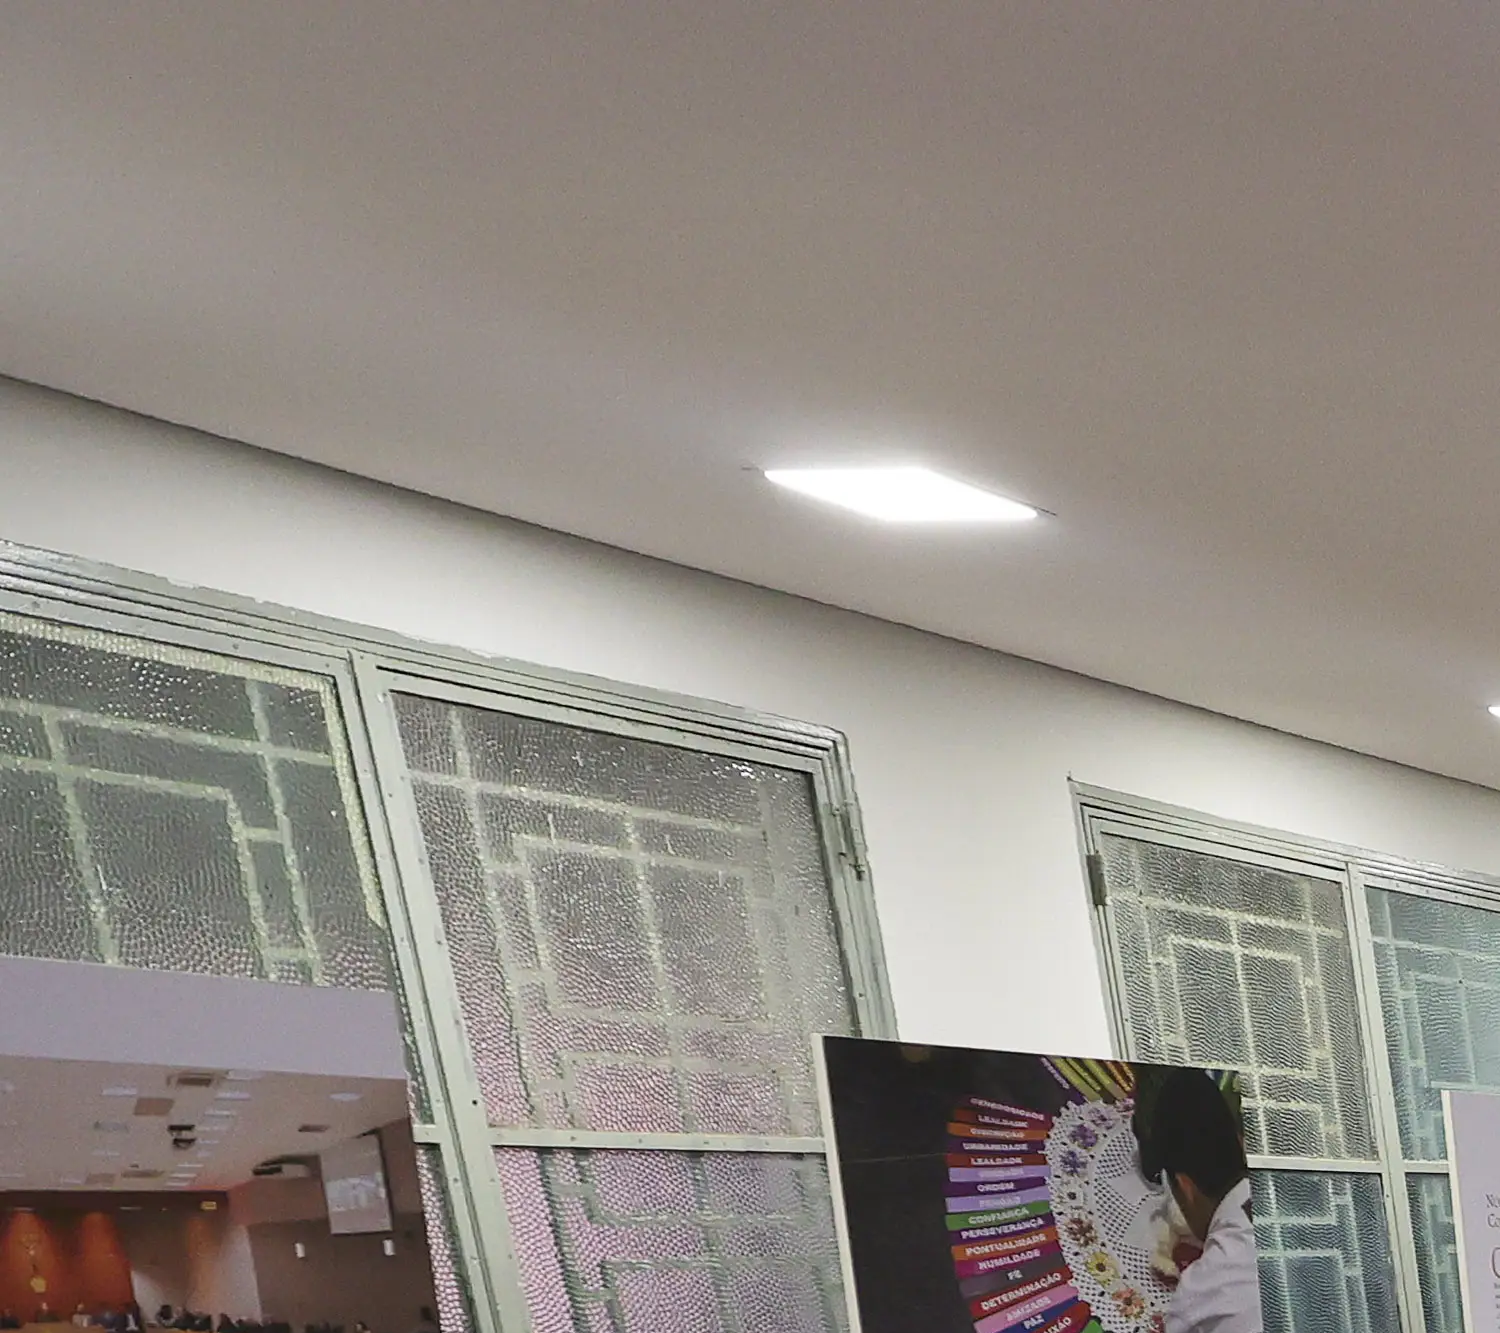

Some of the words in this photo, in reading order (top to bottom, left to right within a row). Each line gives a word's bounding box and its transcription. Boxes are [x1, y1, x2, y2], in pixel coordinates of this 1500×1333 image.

[978, 1249, 1040, 1270] HUMILDADE
[980, 1272, 1061, 1310] DETERMINAÇÃO
[1023, 1314, 1045, 1329] PAZ
